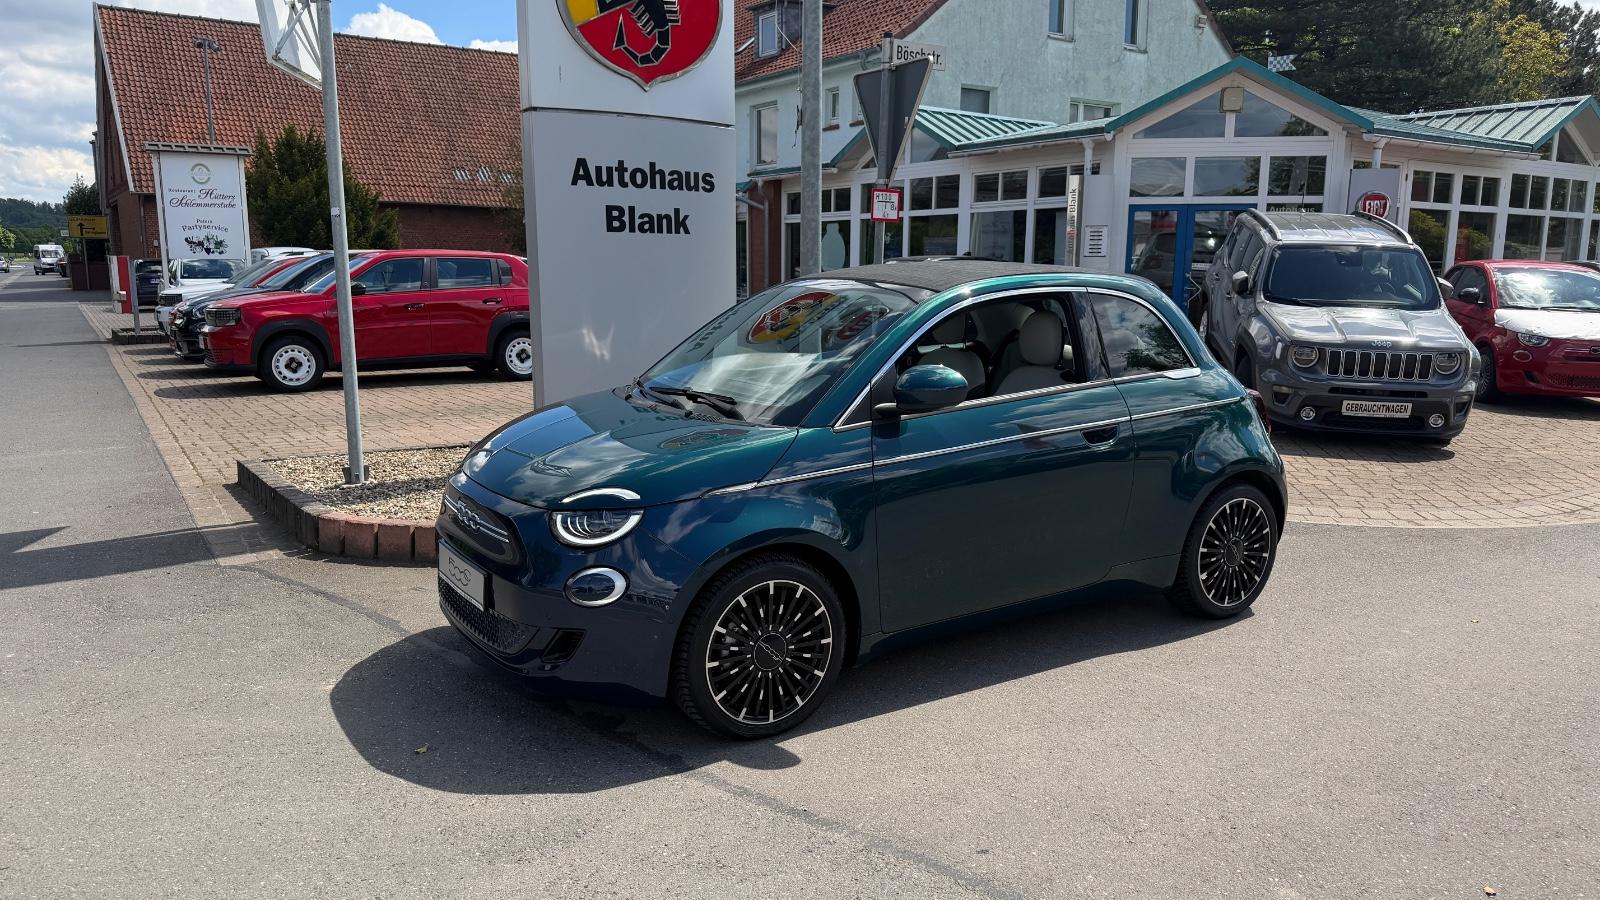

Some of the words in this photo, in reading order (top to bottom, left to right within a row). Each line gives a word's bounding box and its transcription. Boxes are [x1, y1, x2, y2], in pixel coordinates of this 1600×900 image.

[570, 157, 715, 193] Autohaus
[169, 195, 236, 208] Schlemmerstube
[1068, 188, 1077, 213] Blank
[1365, 199, 1386, 215] FIAT
[605, 204, 690, 234] Blank
[1371, 339, 1392, 348] Jeep
[1345, 402, 1409, 414] GEBRAUCHTWAGEN
